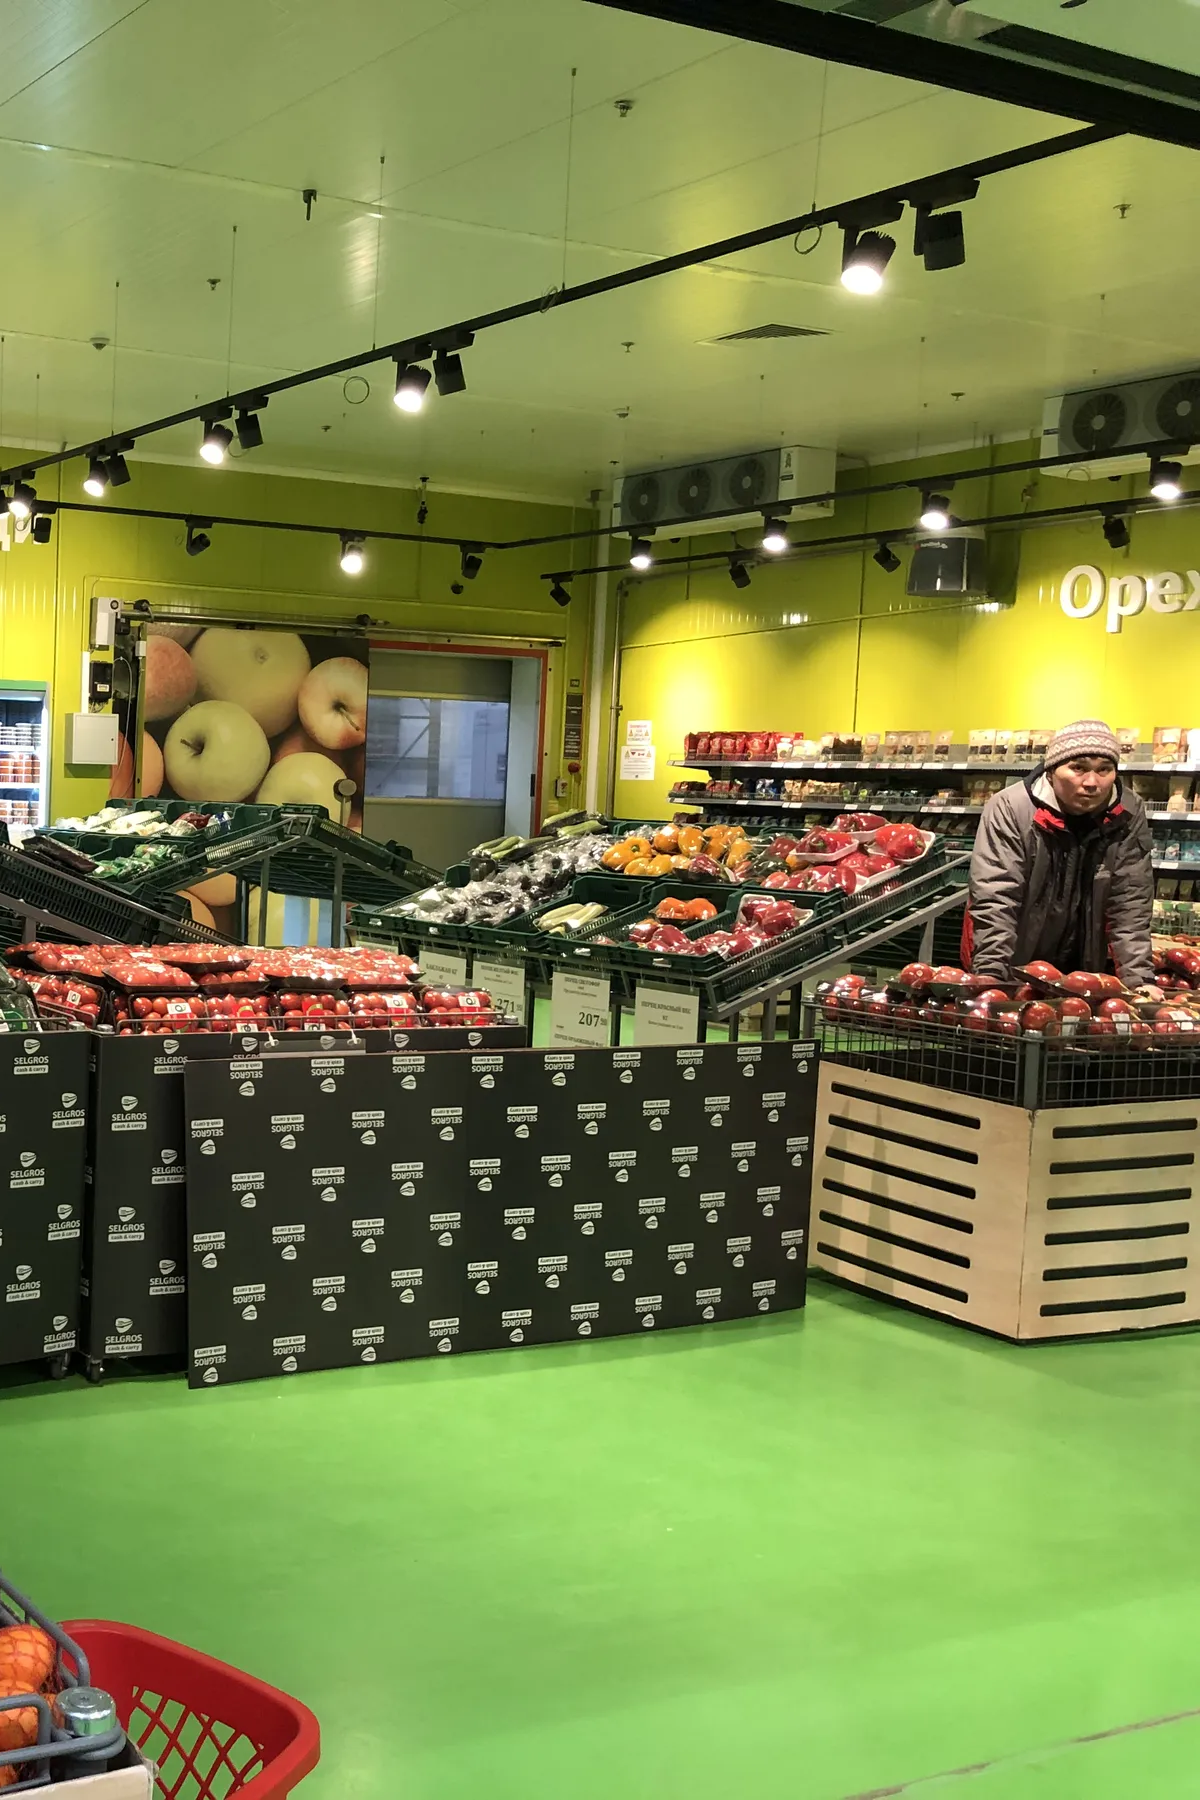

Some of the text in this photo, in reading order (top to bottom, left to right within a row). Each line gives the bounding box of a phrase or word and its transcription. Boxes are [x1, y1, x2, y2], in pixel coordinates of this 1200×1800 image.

[578, 1011, 600, 1027] 207
[14, 1056, 49, 1064] SELGROS
[154, 1056, 188, 1065] SELGROS
[311, 1068, 344, 1076] SELGROS
[392, 1065, 425, 1073] SELGROS
[230, 1071, 263, 1079] SELGROS
[643, 1108, 669, 1116] SELGROS
[704, 1104, 729, 1112] SELGROS
[53, 1109, 85, 1119] SELGROS
[112, 1113, 147, 1121] SELGROS
[352, 1120, 384, 1128] SELGROS
[431, 1116, 462, 1124] SELGROS
[271, 1124, 304, 1132] SELGROS
[191, 1129, 224, 1138] SELGROS
[609, 1159, 636, 1167] SELGROS
[672, 1155, 697, 1163] SELGROS
[541, 1164, 571, 1172] SELGROS
[11, 1168, 45, 1178] SELGROS
[392, 1171, 423, 1180] SELGROS
[312, 1176, 345, 1185] SELGROS
[232, 1182, 264, 1191] SELGROS
[700, 1200, 725, 1209] SELGROS
[639, 1206, 665, 1214] SELGROS
[574, 1212, 602, 1220] SELGROS
[49, 1220, 80, 1231] SELGROS
[504, 1217, 534, 1225] SELGROS
[109, 1223, 145, 1232] SELGROS
[430, 1222, 460, 1231] SELGROS
[352, 1228, 384, 1237] SELGROS
[272, 1234, 305, 1244] SELGROS
[194, 1241, 225, 1252] SELGROS
[668, 1252, 694, 1260] SELGROS
[605, 1258, 632, 1267] SELGROS
[538, 1264, 567, 1273] SELGROS
[467, 1270, 498, 1279] SELGROS
[150, 1277, 184, 1285] SELGROS
[391, 1278, 422, 1287] SELGROS
[7, 1281, 40, 1292] SELGROS
[313, 1285, 345, 1295] SELGROS
[233, 1294, 265, 1304] SELGROS
[696, 1296, 721, 1305] SELGROS
[635, 1304, 661, 1313] SELGROS
[571, 1311, 599, 1320] SELGROS
[502, 1318, 531, 1327] SELGROS
[429, 1327, 459, 1337] SELGROS
[44, 1331, 75, 1343] SELGROS
[105, 1334, 142, 1344] SELGROS
[352, 1335, 384, 1346] SELGROS
[273, 1345, 306, 1355] SELGROS
[194, 1355, 226, 1367] SELGROS
